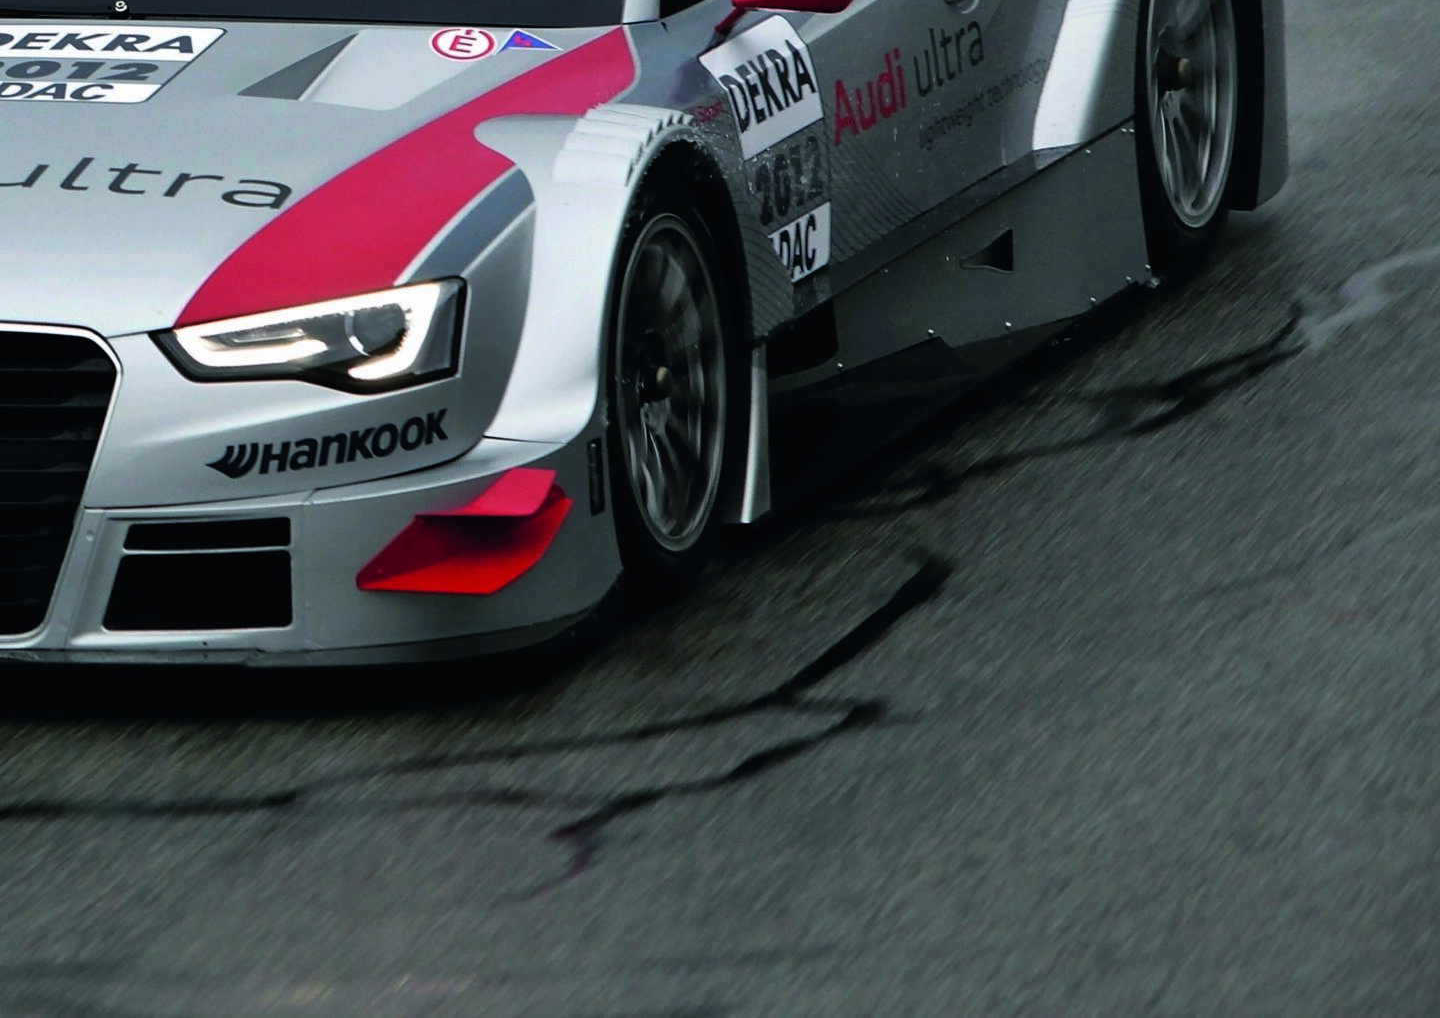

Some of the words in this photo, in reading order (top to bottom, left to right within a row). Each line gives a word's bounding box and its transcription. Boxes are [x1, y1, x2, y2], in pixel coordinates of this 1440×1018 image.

[718, 39, 817, 133] DEKRA
[832, 47, 907, 147] Audi
[913, 21, 984, 97] ultra
[770, 213, 816, 278] DAC
